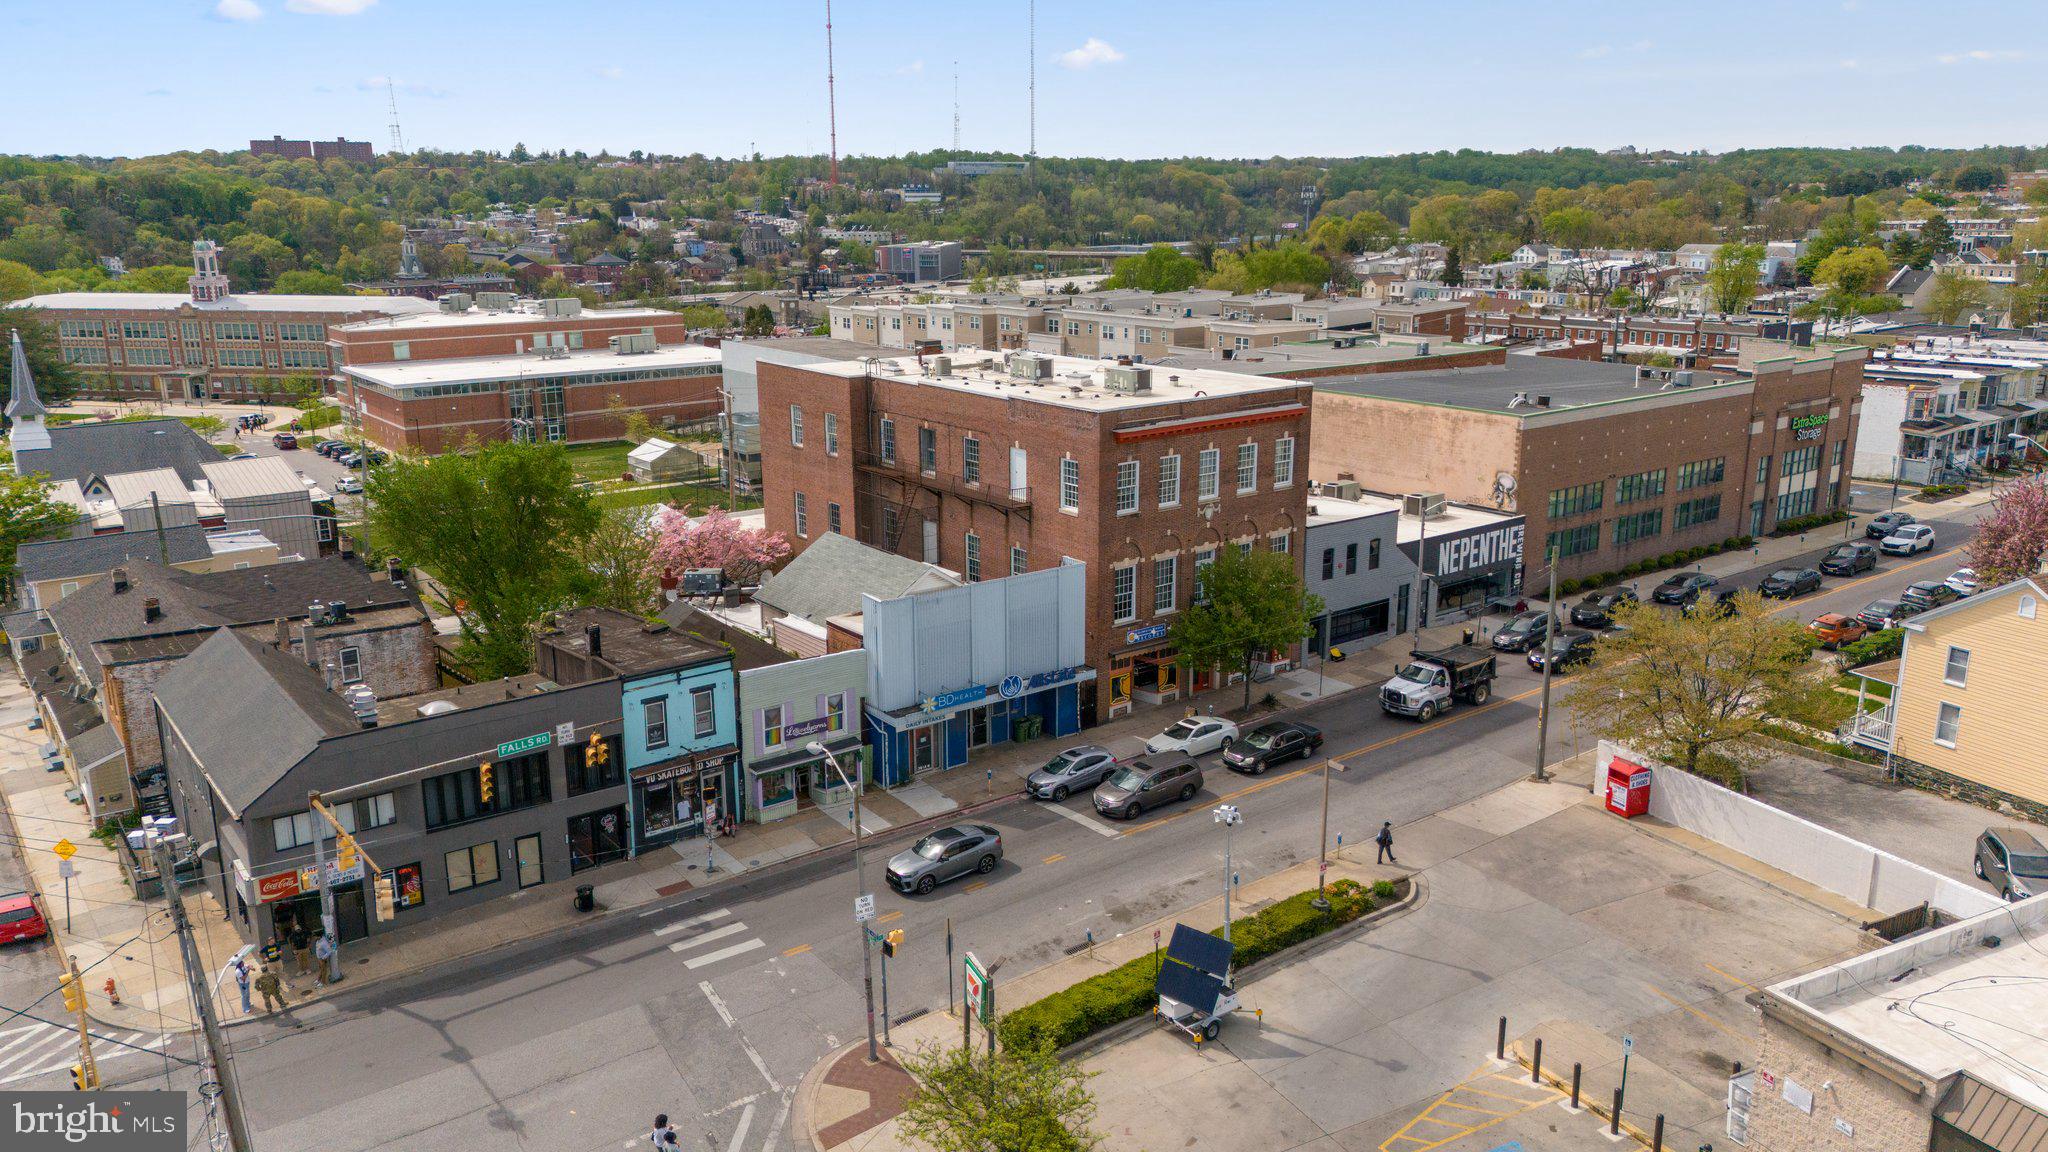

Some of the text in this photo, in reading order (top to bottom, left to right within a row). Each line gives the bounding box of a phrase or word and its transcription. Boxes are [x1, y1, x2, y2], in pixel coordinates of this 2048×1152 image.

[1797, 428, 1821, 441] Storage
[1438, 525, 1518, 577] NEPENTHE
[1515, 524, 1525, 569] BREWING
[938, 690, 983, 707] BD HEALTH
[906, 720, 921, 729] DAILY
[501, 738, 534, 754] FALLS
[645, 773, 656, 784] VU
[705, 757, 724, 768] SHOP
[262, 875, 295, 893] Coca-Cola
[860, 896, 868, 904] NO
